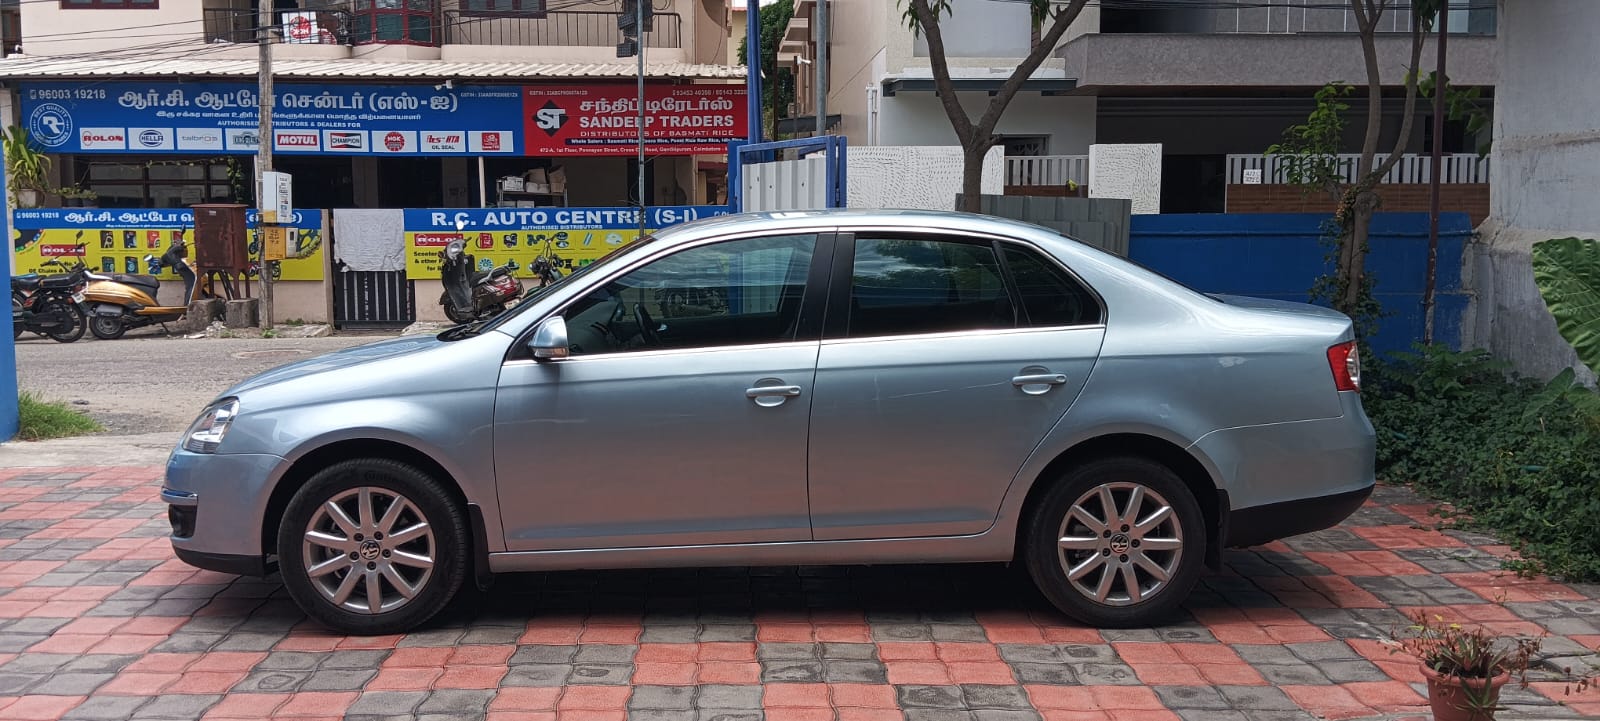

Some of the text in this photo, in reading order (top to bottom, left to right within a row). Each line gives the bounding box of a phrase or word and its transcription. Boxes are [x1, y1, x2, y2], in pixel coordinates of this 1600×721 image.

[38, 89, 106, 99] 96003 19218
[118, 89, 190, 110] ஆர்.சி.
[282, 91, 364, 110] சென்டர்
[645, 97, 733, 114] டிரேடர்ஸ்
[536, 108, 566, 129] ST
[659, 115, 734, 127] TRADERS
[279, 136, 315, 144] MOTUL
[64, 211, 115, 224] ஆர்.சி.
[118, 211, 177, 224] ஆட்டோ
[431, 211, 476, 226] R.C.
[484, 211, 548, 225] AUTO
[654, 207, 698, 225] (S-I)
